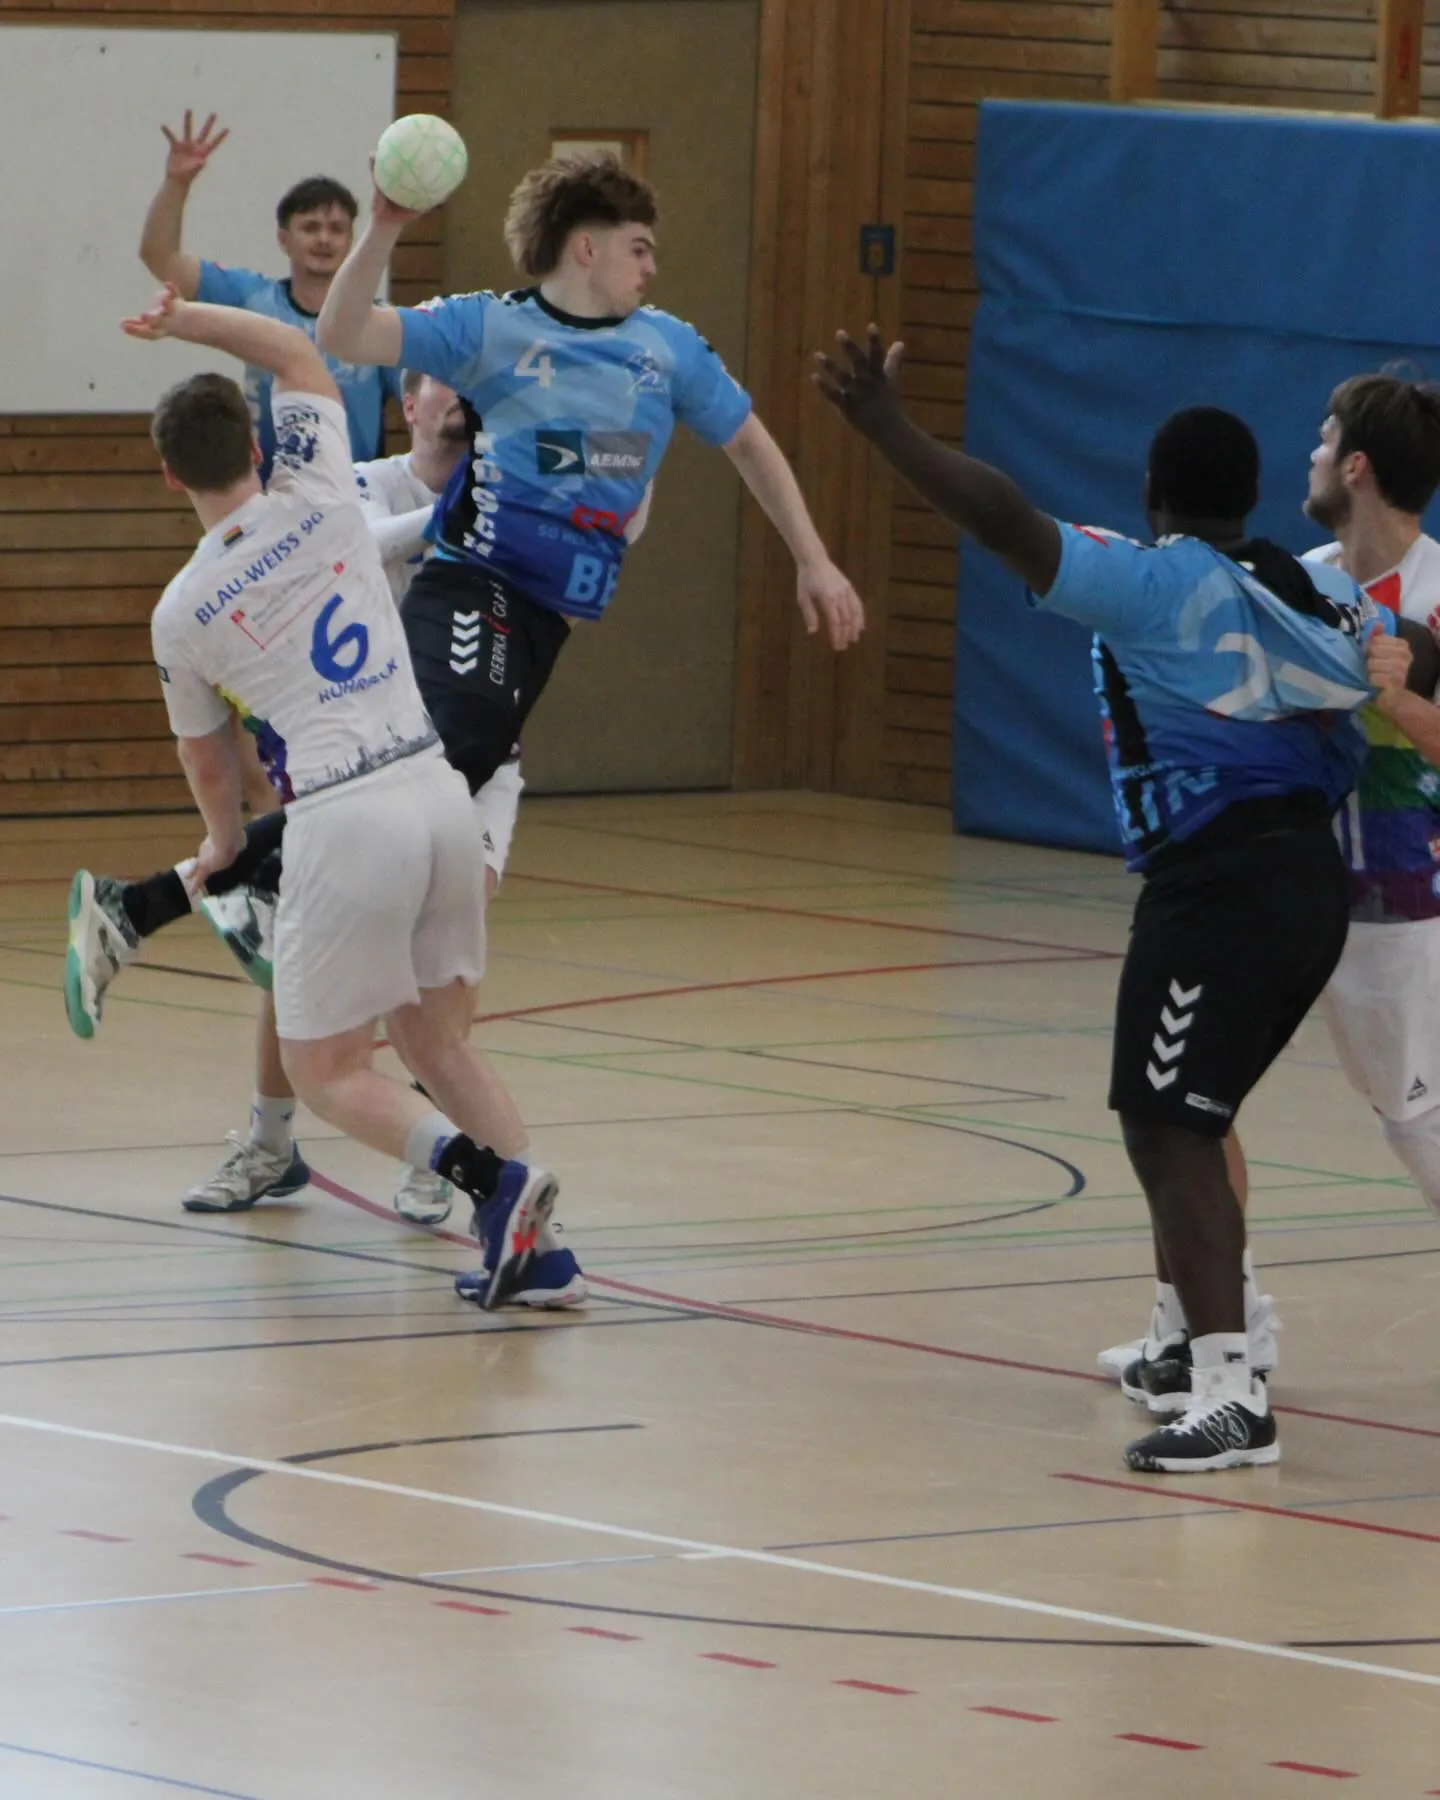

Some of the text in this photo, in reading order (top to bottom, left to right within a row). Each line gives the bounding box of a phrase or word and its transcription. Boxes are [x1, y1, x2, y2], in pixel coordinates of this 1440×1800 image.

[513, 338, 556, 388] 4
[194, 531, 301, 627] BLAU-WEISS
[299, 511, 325, 535] 90
[310, 592, 370, 684] 6
